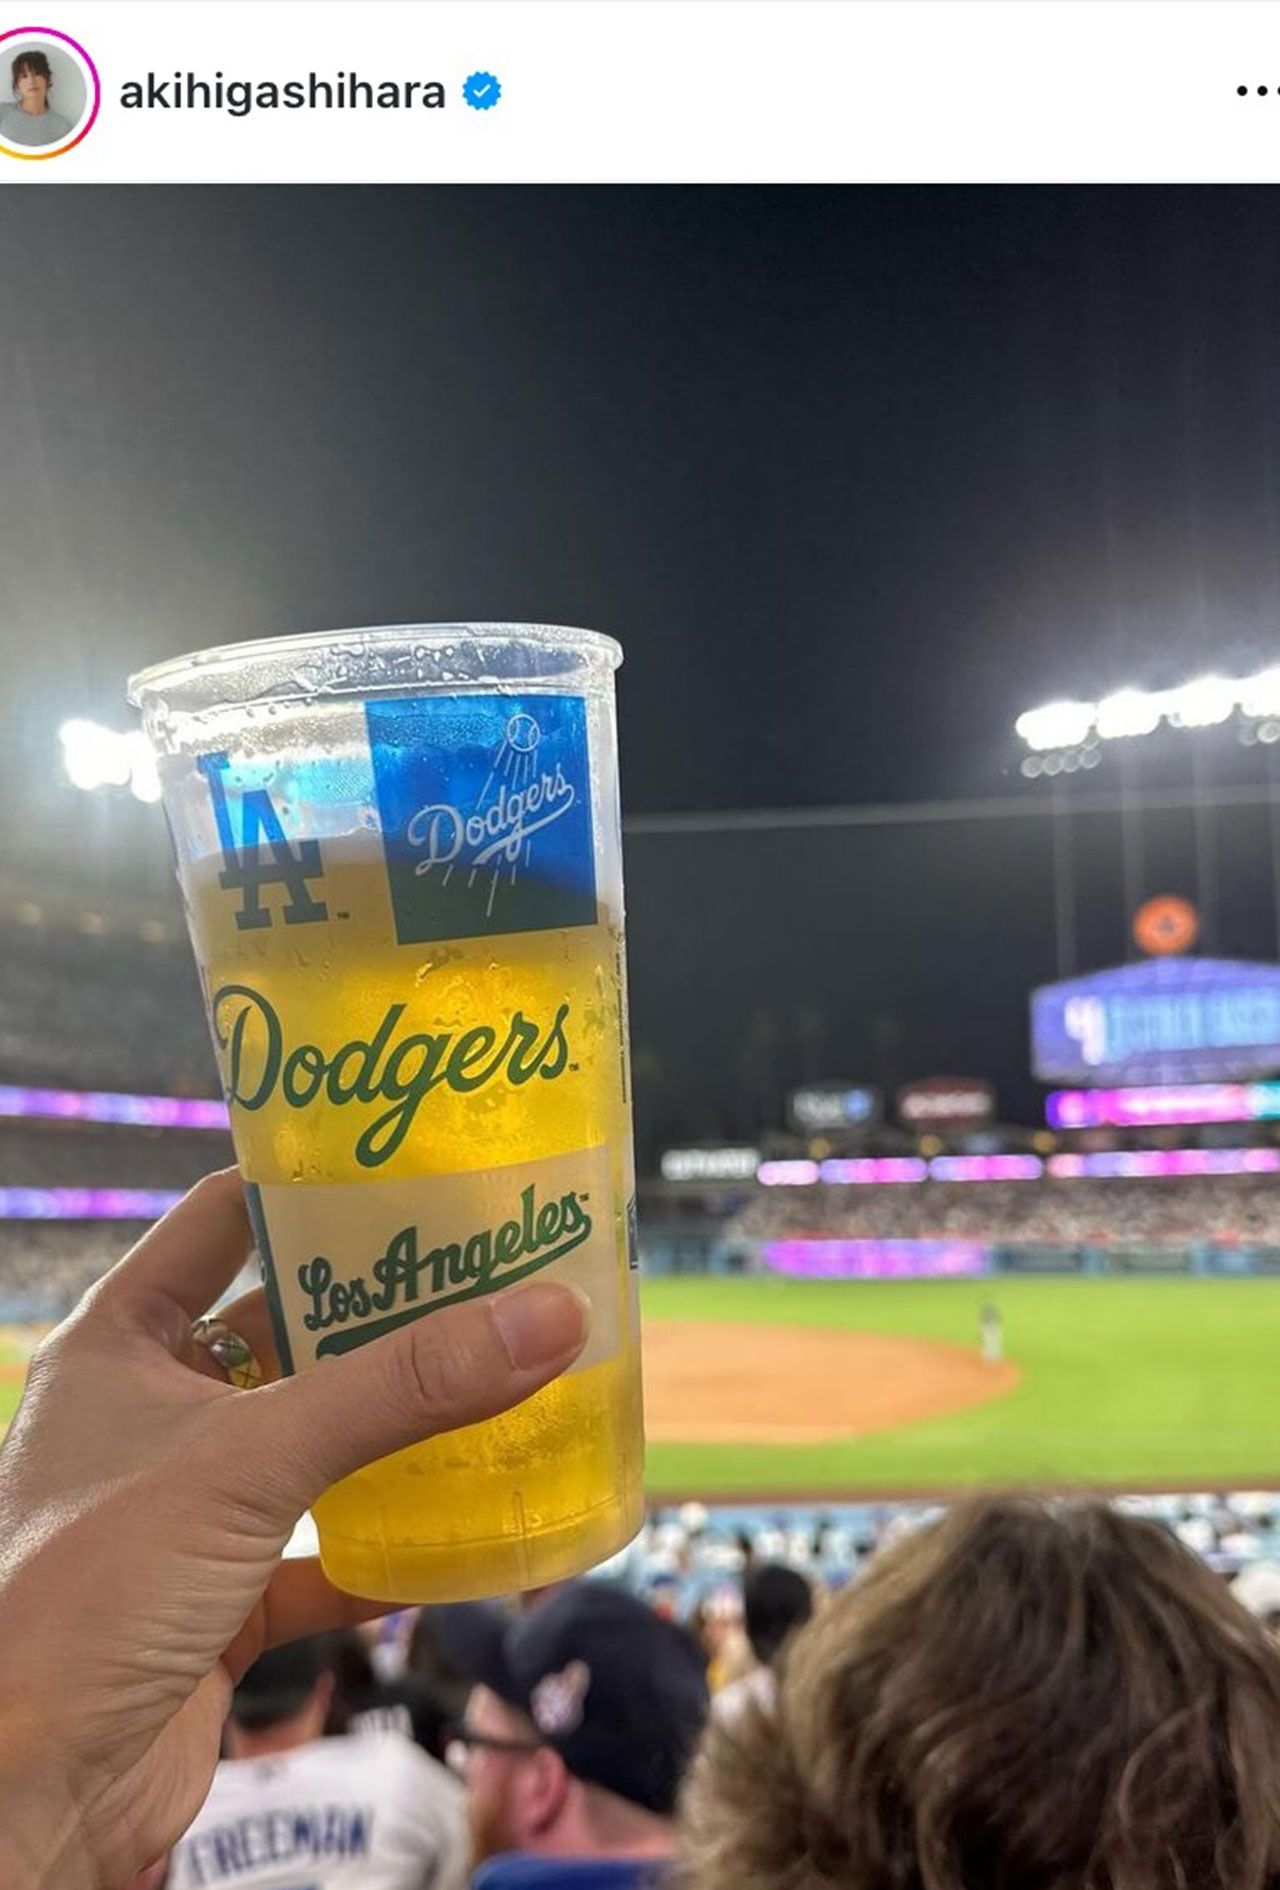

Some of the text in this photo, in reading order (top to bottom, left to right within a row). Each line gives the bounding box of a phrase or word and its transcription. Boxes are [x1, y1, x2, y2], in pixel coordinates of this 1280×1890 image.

[196, 750, 328, 930] LA
[407, 762, 575, 876] Dodgers
[212, 984, 570, 1167] Dodgers
[298, 1183, 593, 1331] Los Angeles
[187, 1803, 374, 1884] FREEMAN
